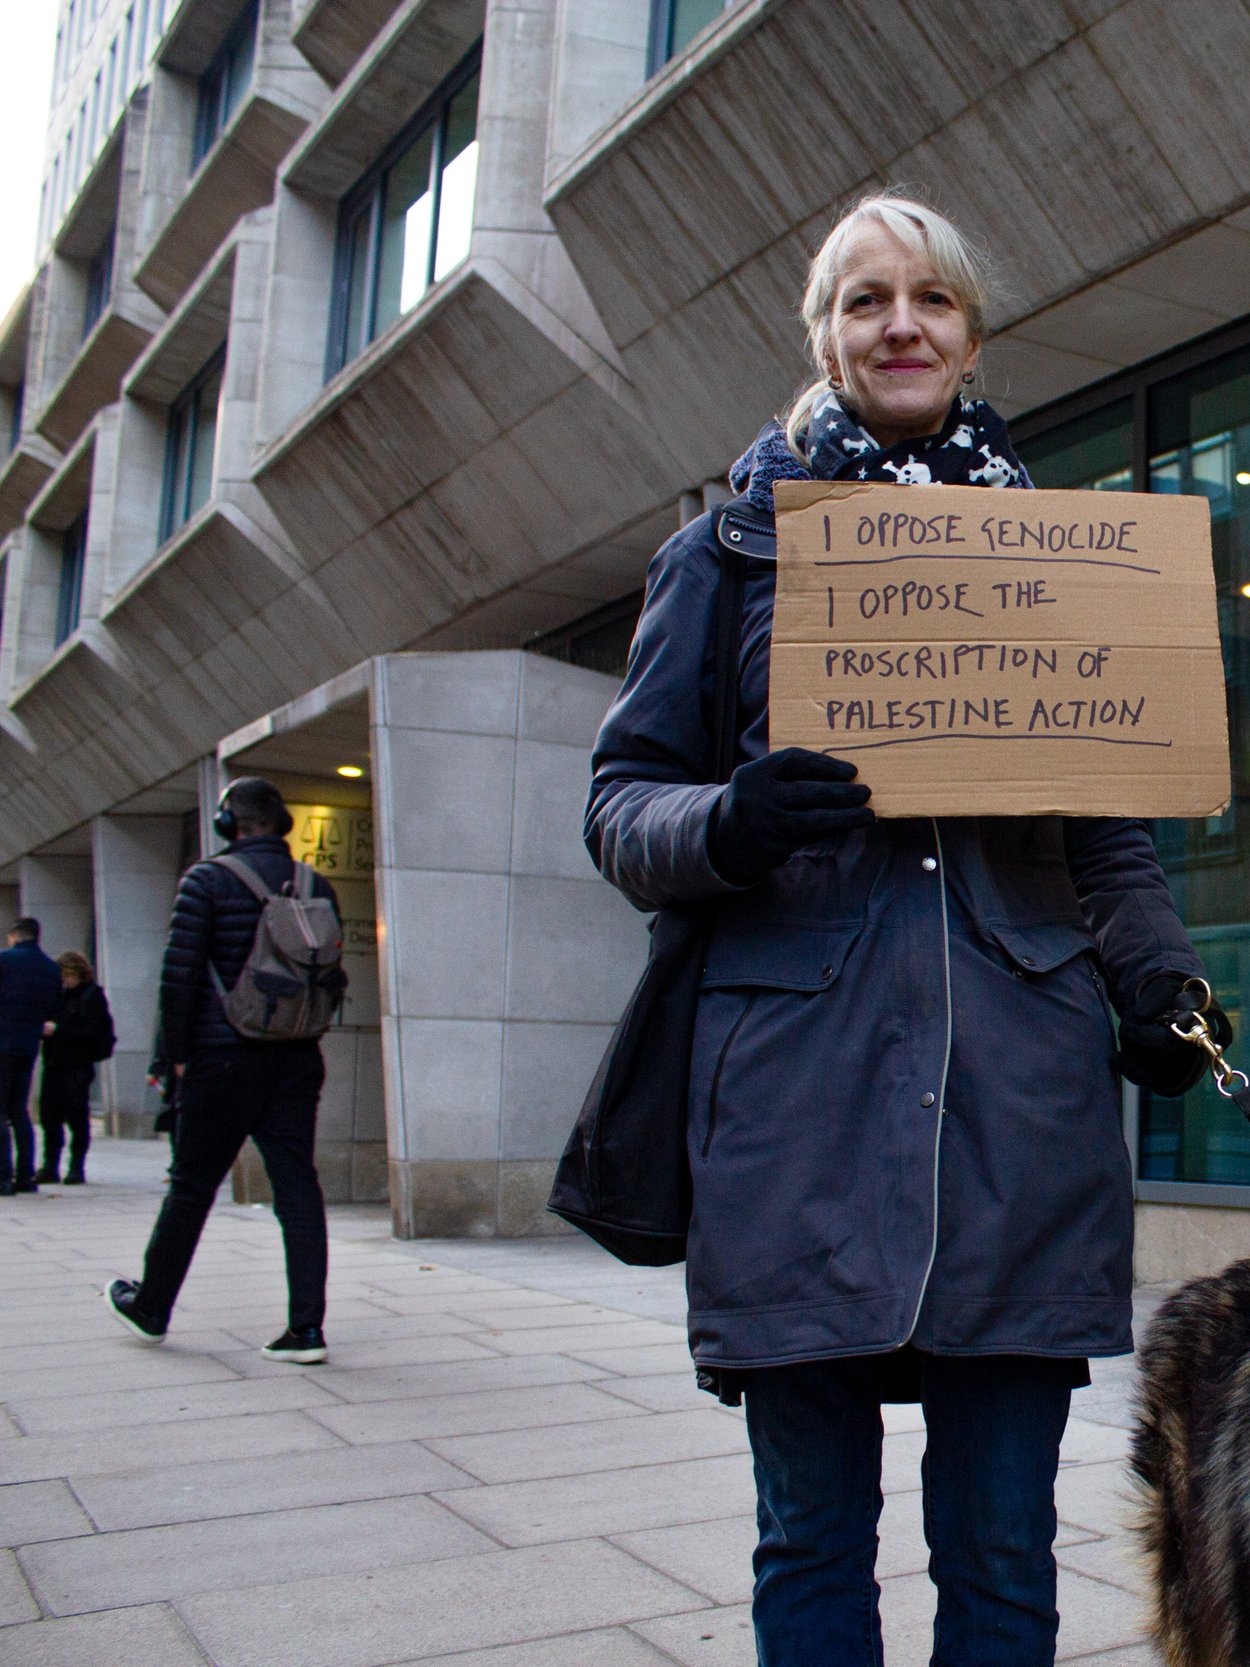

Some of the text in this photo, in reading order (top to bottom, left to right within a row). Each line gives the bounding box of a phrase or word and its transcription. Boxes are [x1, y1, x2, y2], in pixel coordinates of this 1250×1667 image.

[822, 512, 1138, 553] I OPPOSE GENOCIDE
[827, 579, 1057, 627] I OPPOSE THE
[825, 644, 1112, 679] PROSCRIPTION OF
[826, 696, 1146, 731] PALESTINE ACTION
[302, 852, 338, 869] CPS
